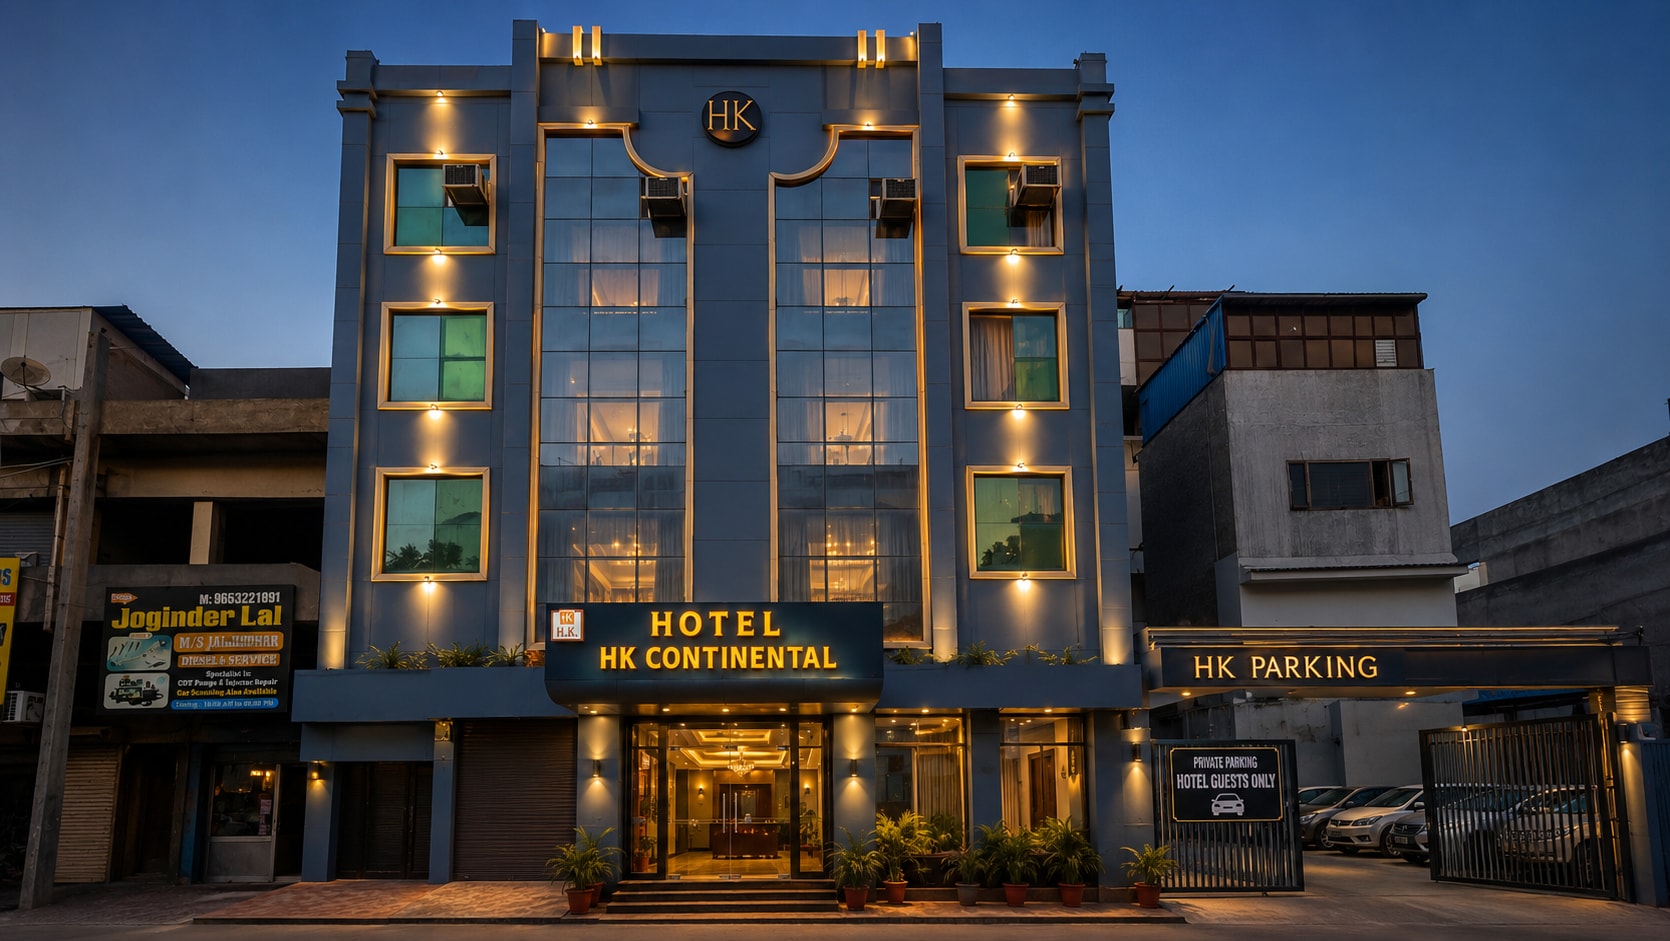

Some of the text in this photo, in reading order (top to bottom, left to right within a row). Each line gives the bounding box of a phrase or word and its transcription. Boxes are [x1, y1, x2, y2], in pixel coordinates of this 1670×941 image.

[707, 100, 757, 131] HK
[111, 605, 282, 632] Joginder Lal
[650, 610, 781, 637] HOTEL
[557, 627, 578, 637] H.K.
[600, 645, 838, 670] HK CONTINENTAL
[1193, 655, 1379, 679] HK PARKING
[1193, 756, 1258, 769] PRIVATE PARKING
[1176, 773, 1276, 789] HOTEL GUESTS ONLY
